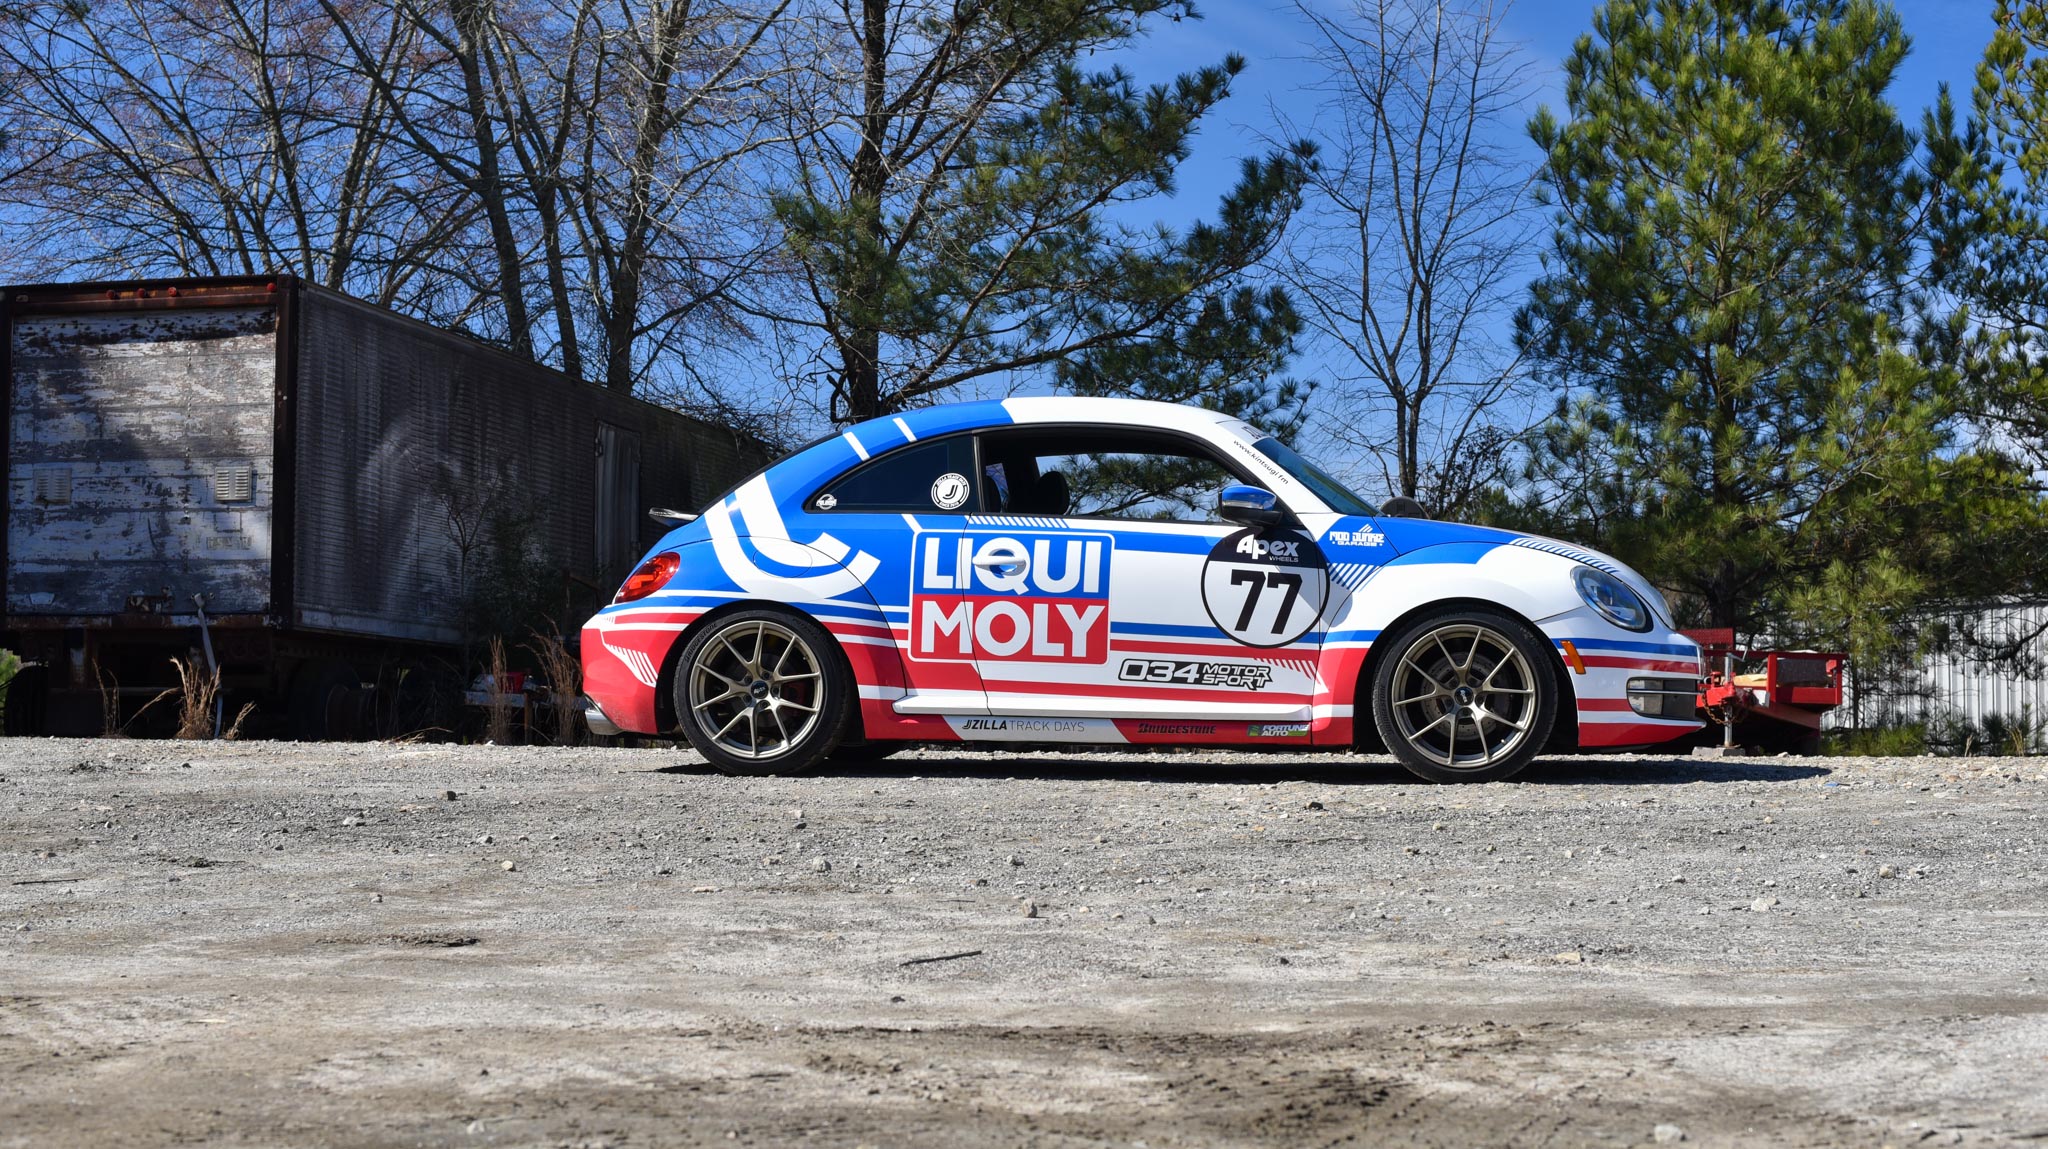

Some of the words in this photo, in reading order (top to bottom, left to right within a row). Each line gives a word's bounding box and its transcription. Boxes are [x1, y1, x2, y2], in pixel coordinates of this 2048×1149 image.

[1233, 440, 1289, 485] www.kintsugifm
[923, 537, 1102, 595] LIQUI
[1269, 555, 1299, 563] WHEELS
[1230, 569, 1303, 634] 77
[921, 600, 1106, 657] MOLY
[1119, 660, 1200, 683] 034
[1201, 674, 1267, 689] SPORT
[1202, 664, 1270, 681] MOTOR
[1009, 720, 1051, 731] TRACK
[1054, 721, 1085, 732] DAYS
[1137, 722, 1216, 734] BRIDGESTONE
